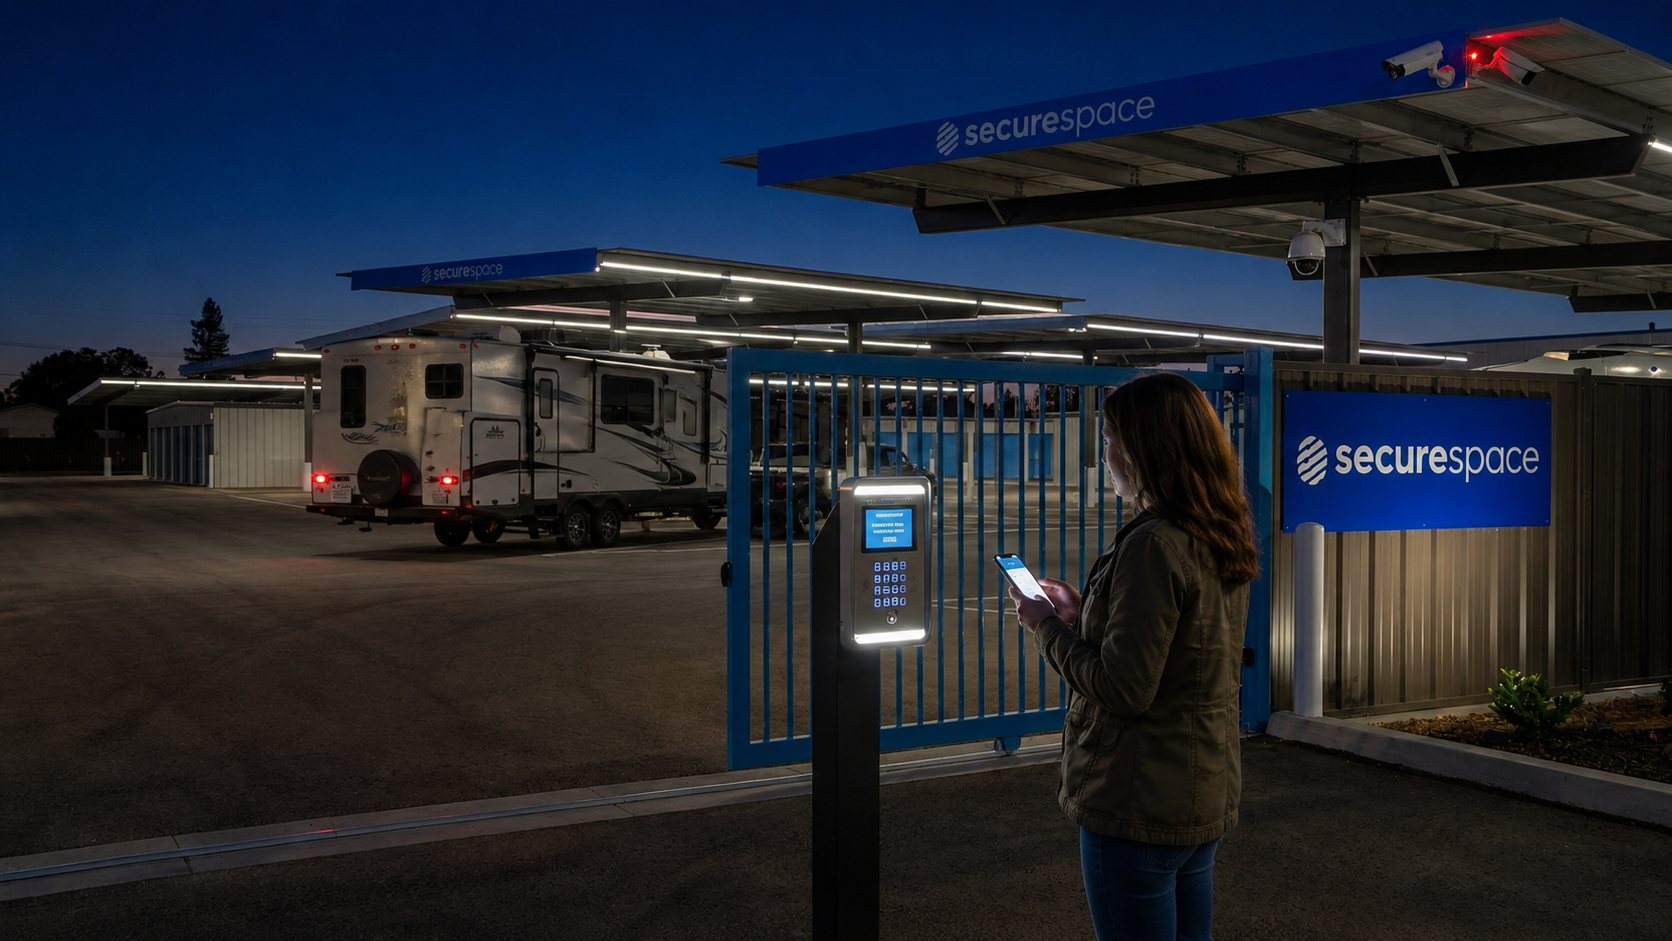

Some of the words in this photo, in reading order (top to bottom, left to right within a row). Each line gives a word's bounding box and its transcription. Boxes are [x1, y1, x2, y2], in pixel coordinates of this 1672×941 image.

[965, 97, 1155, 145] securespace
[434, 264, 503, 280] securespace
[1335, 444, 1539, 482] securespace
